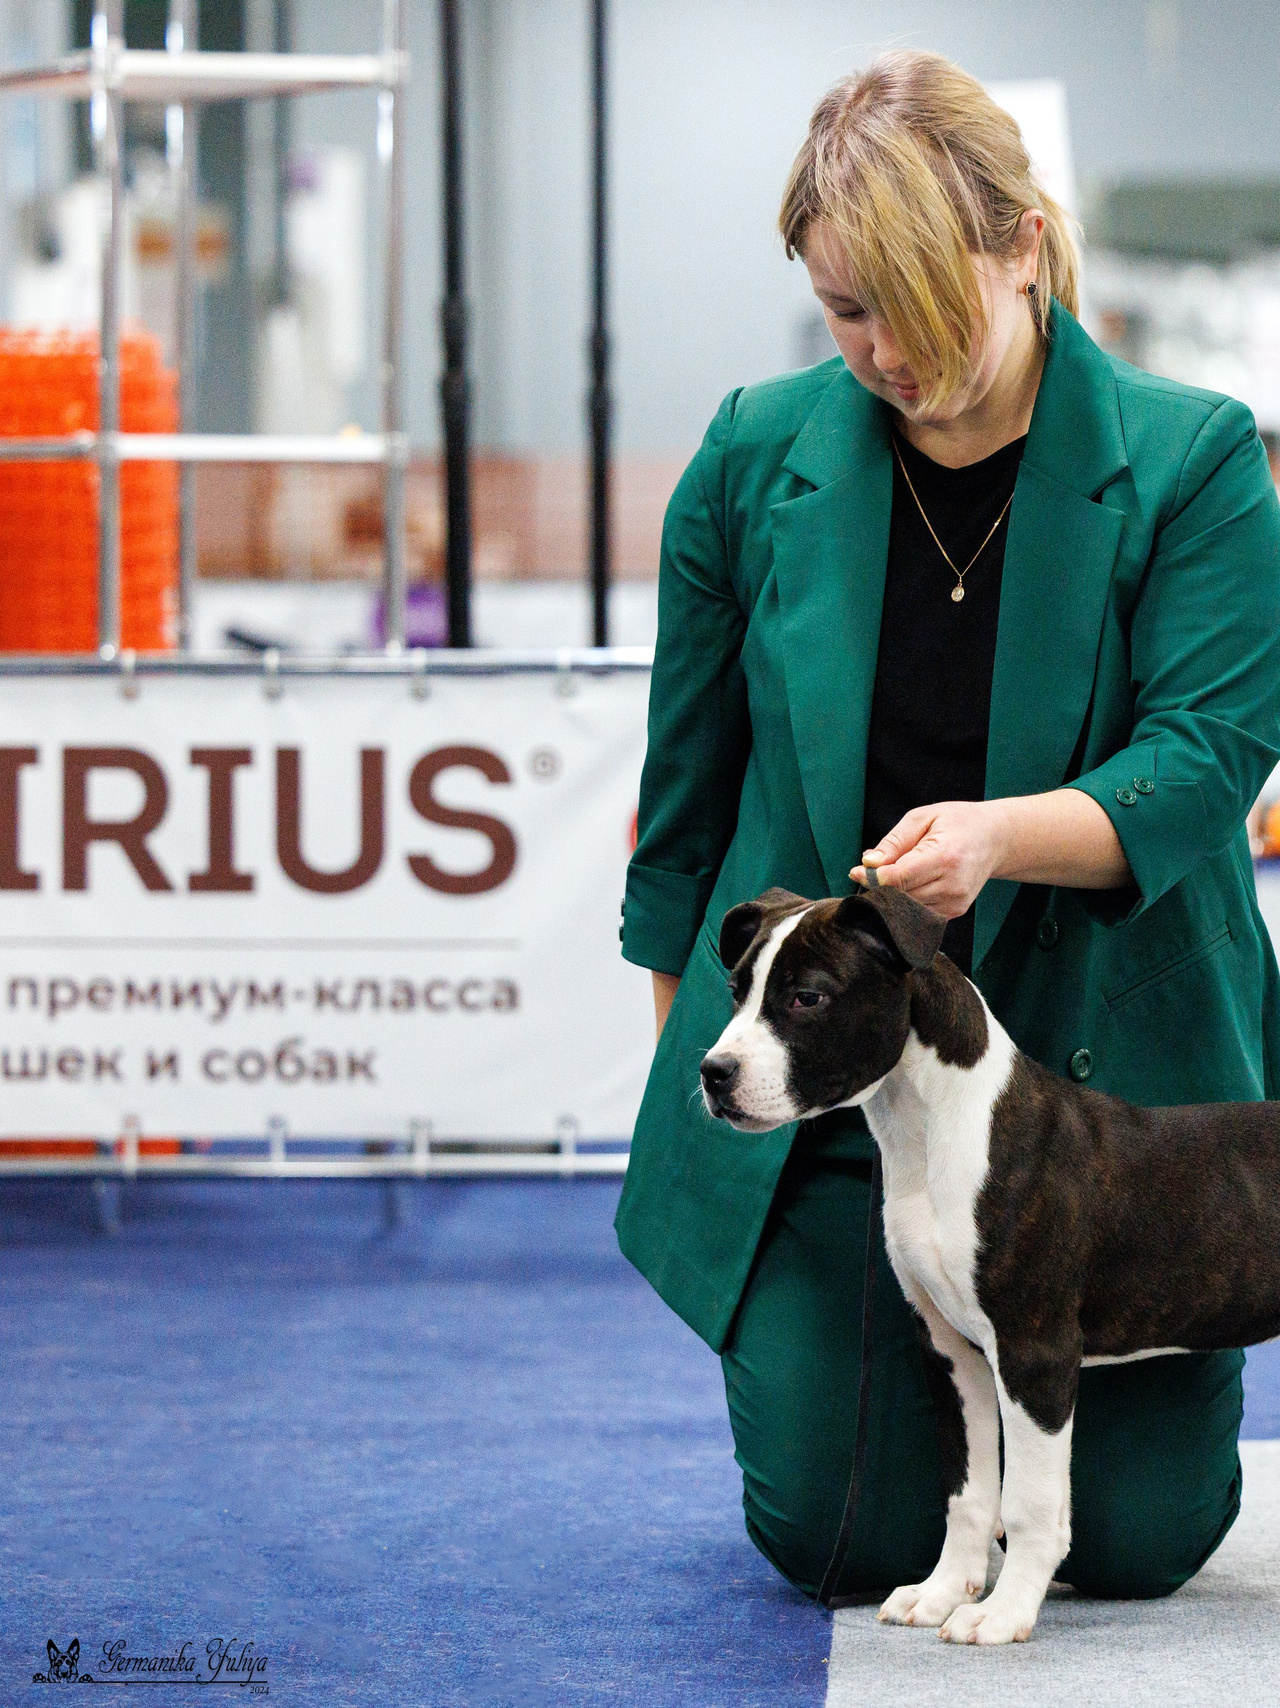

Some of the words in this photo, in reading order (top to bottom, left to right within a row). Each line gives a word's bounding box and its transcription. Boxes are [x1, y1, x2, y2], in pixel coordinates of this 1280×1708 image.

[7, 975, 521, 1024] премиум-класса
[146, 1046, 179, 1083] и
[201, 1034, 377, 1084] собак
